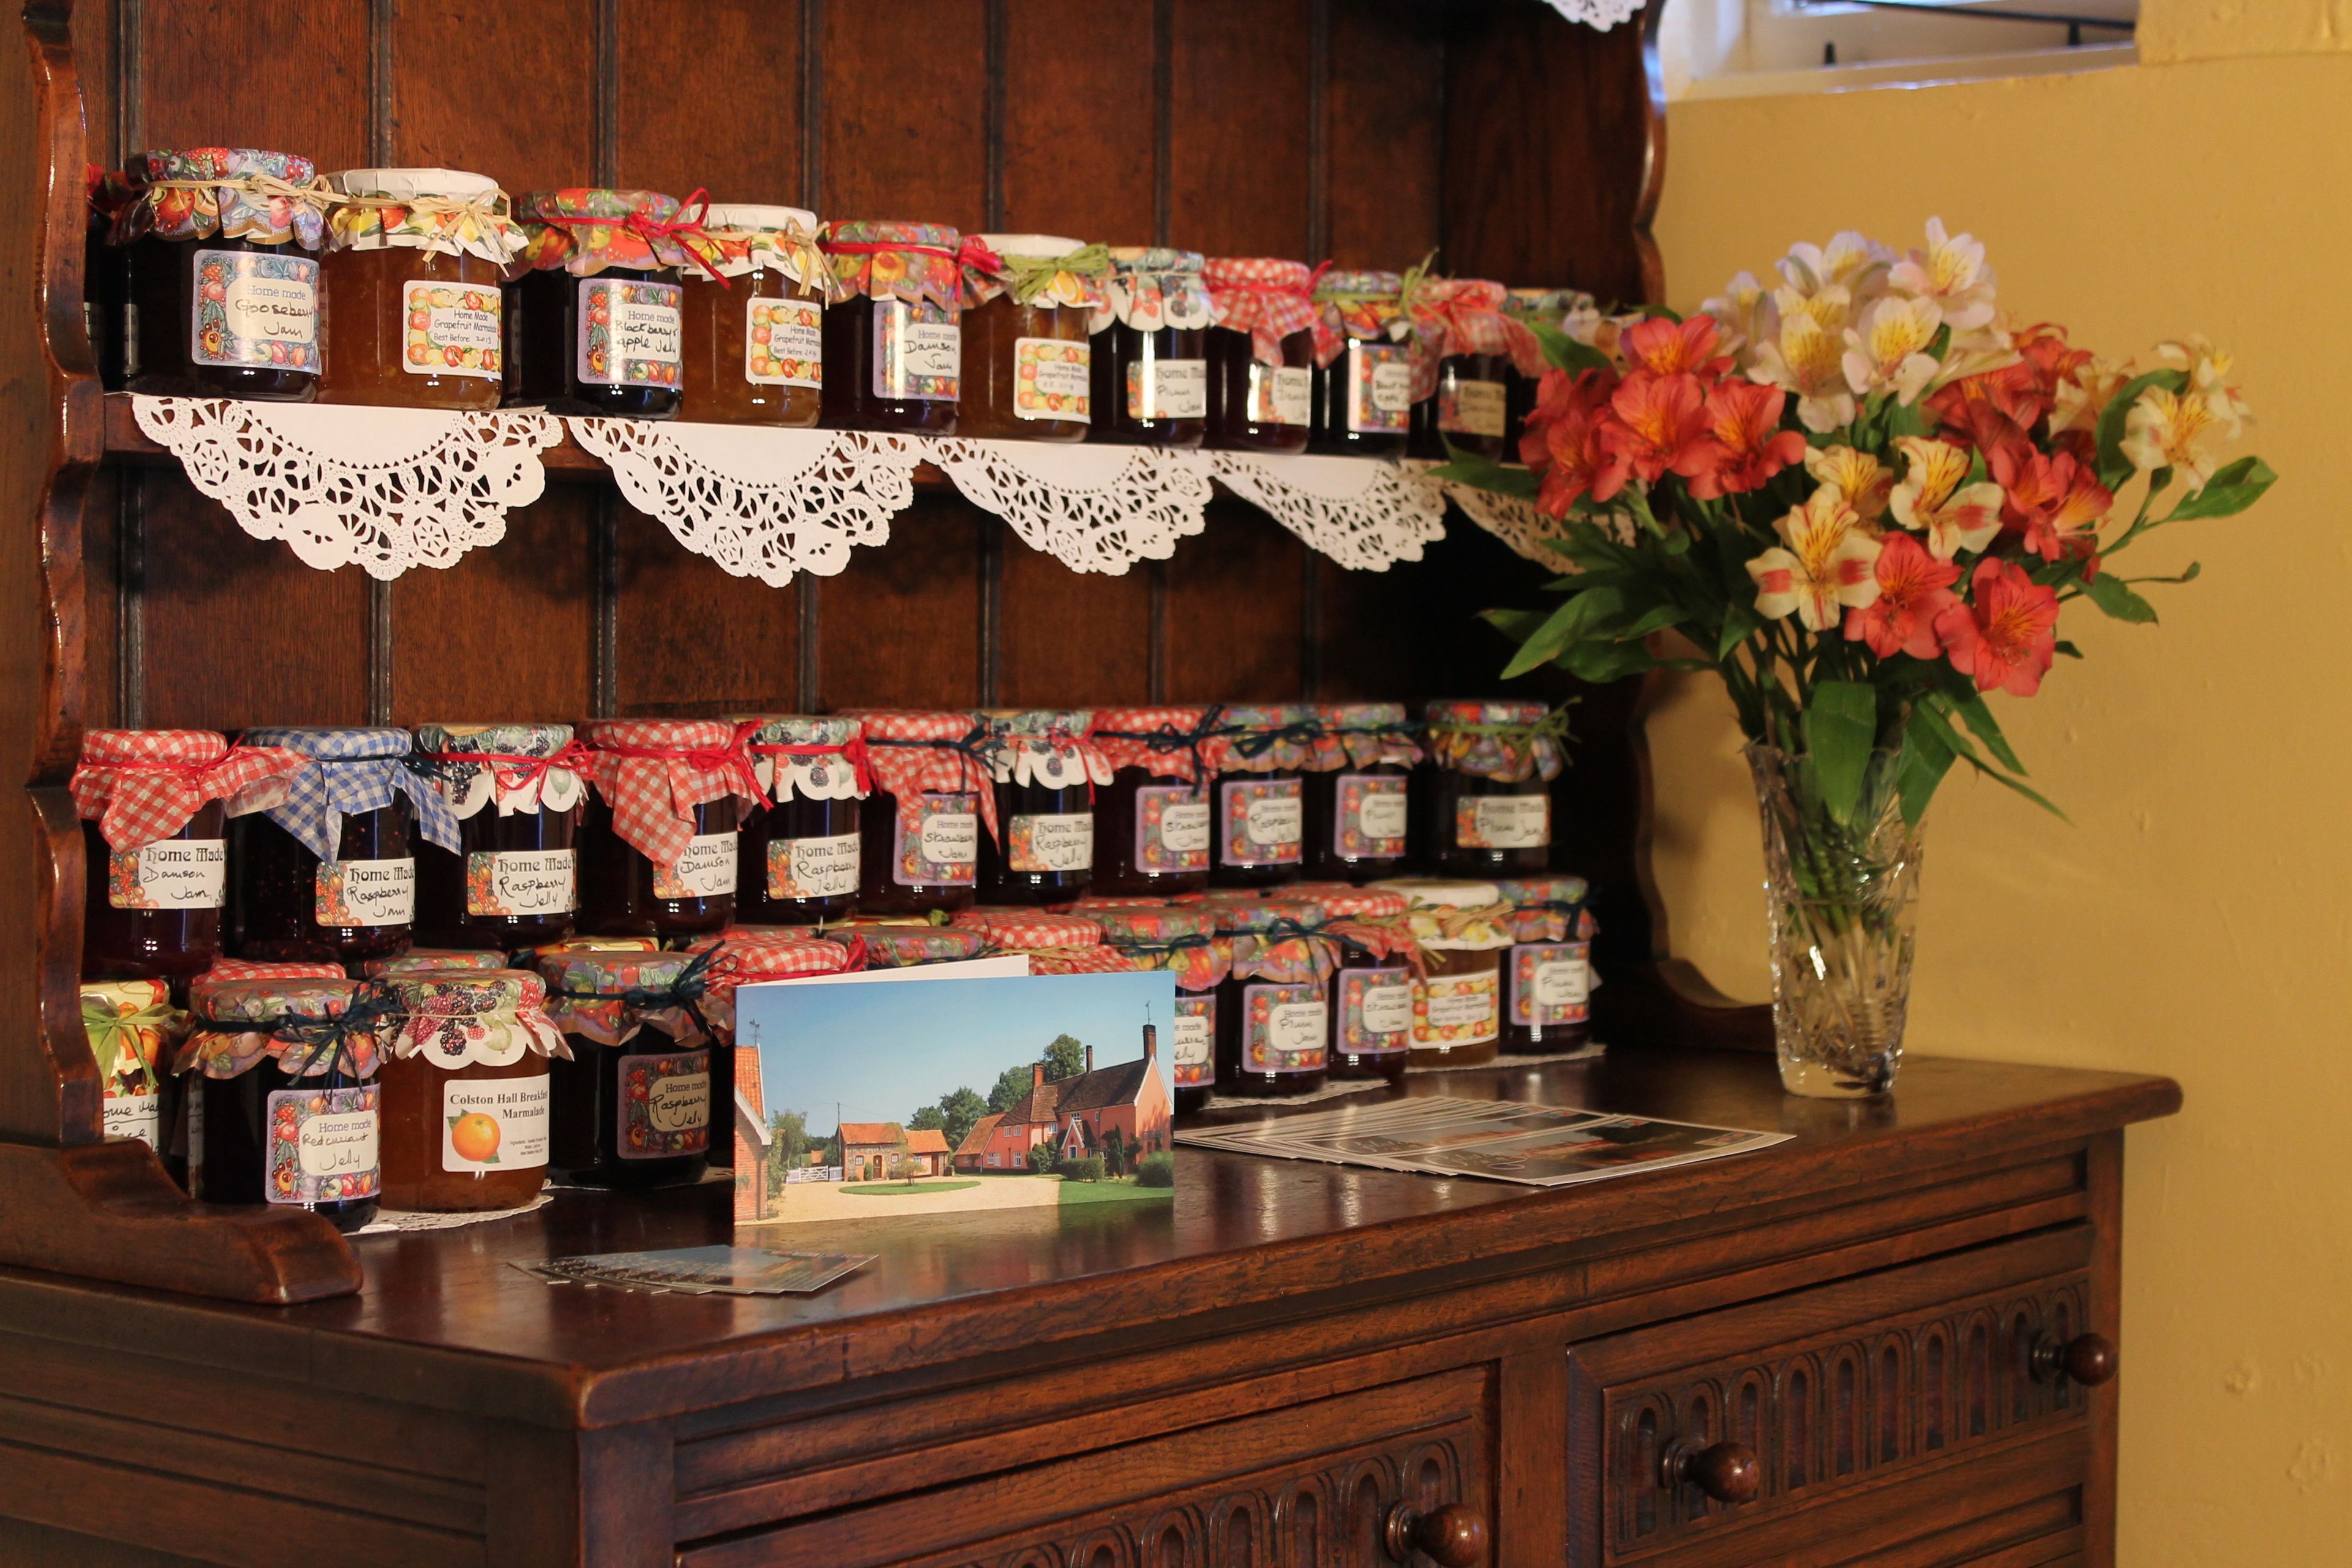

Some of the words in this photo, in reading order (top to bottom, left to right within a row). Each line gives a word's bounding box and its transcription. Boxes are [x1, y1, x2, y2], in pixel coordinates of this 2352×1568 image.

[247, 285, 279, 297] Home
[282, 290, 306, 300] made
[454, 309, 473, 320] Home
[628, 311, 655, 322] Home
[657, 314, 676, 325] made
[263, 322, 303, 339] Jam
[434, 318, 472, 331] Grapefruit
[145, 847, 191, 864] Home
[196, 847, 224, 862] Made
[795, 845, 834, 861] Home
[497, 859, 540, 874] Home
[545, 857, 572, 871] Made
[680, 856, 731, 874] Damson
[143, 867, 205, 883] Damson
[349, 868, 390, 884] Home
[699, 873, 731, 892] Jam
[499, 876, 566, 898] Raspberry
[812, 876, 847, 895] Jelly
[347, 886, 409, 907] Raspberry
[519, 891, 559, 908] Jelly
[666, 1083, 690, 1093] Home
[450, 1094, 494, 1105] Colston
[497, 1093, 518, 1104] Hall
[502, 1105, 545, 1120] Marmalade
[318, 1122, 349, 1133] Home
[351, 1118, 372, 1131] made
